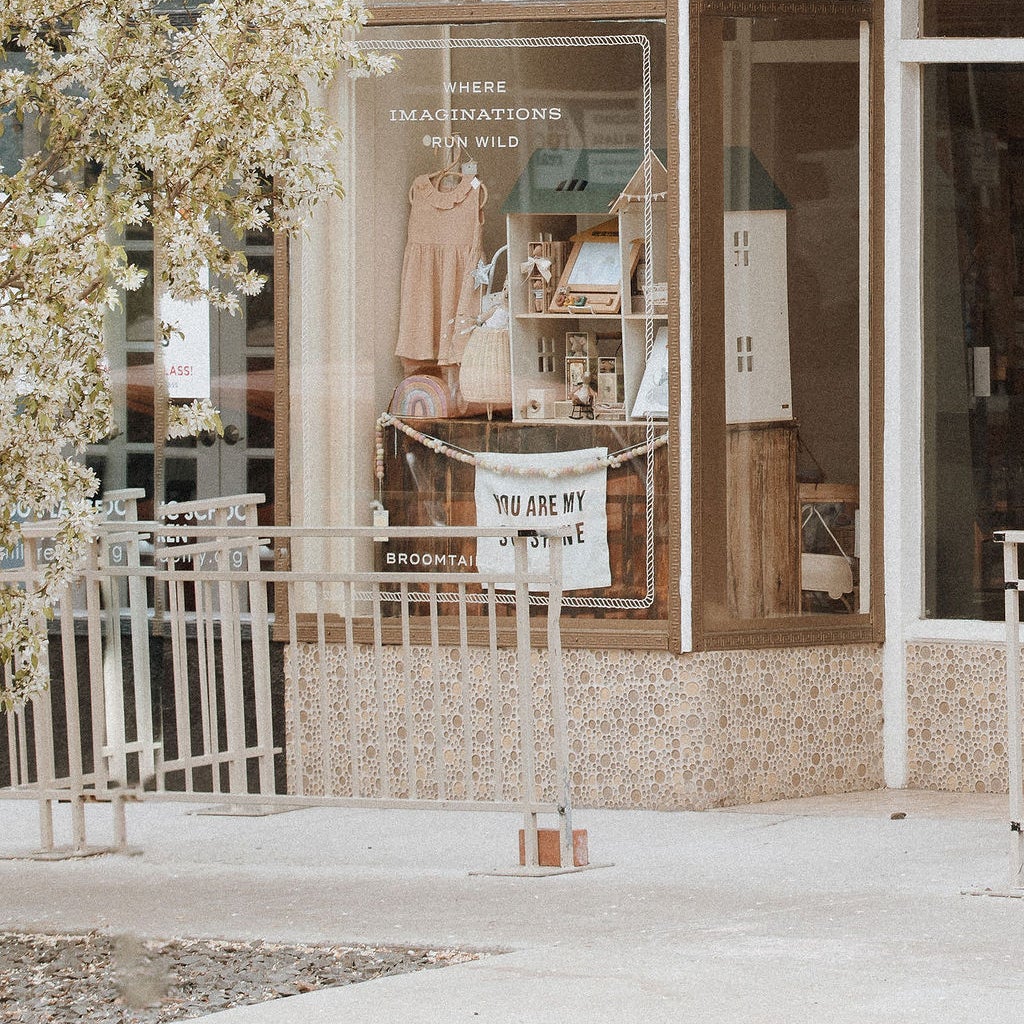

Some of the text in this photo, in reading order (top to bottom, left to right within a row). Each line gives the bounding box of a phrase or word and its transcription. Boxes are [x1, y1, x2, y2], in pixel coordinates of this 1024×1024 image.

[443, 81, 507, 94] WHERE
[389, 107, 562, 121] IMAGINATIONS
[431, 135, 519, 149] RUN WILD
[493, 489, 586, 517] YOU ARE MY
[386, 552, 478, 567] BROOMTAI
